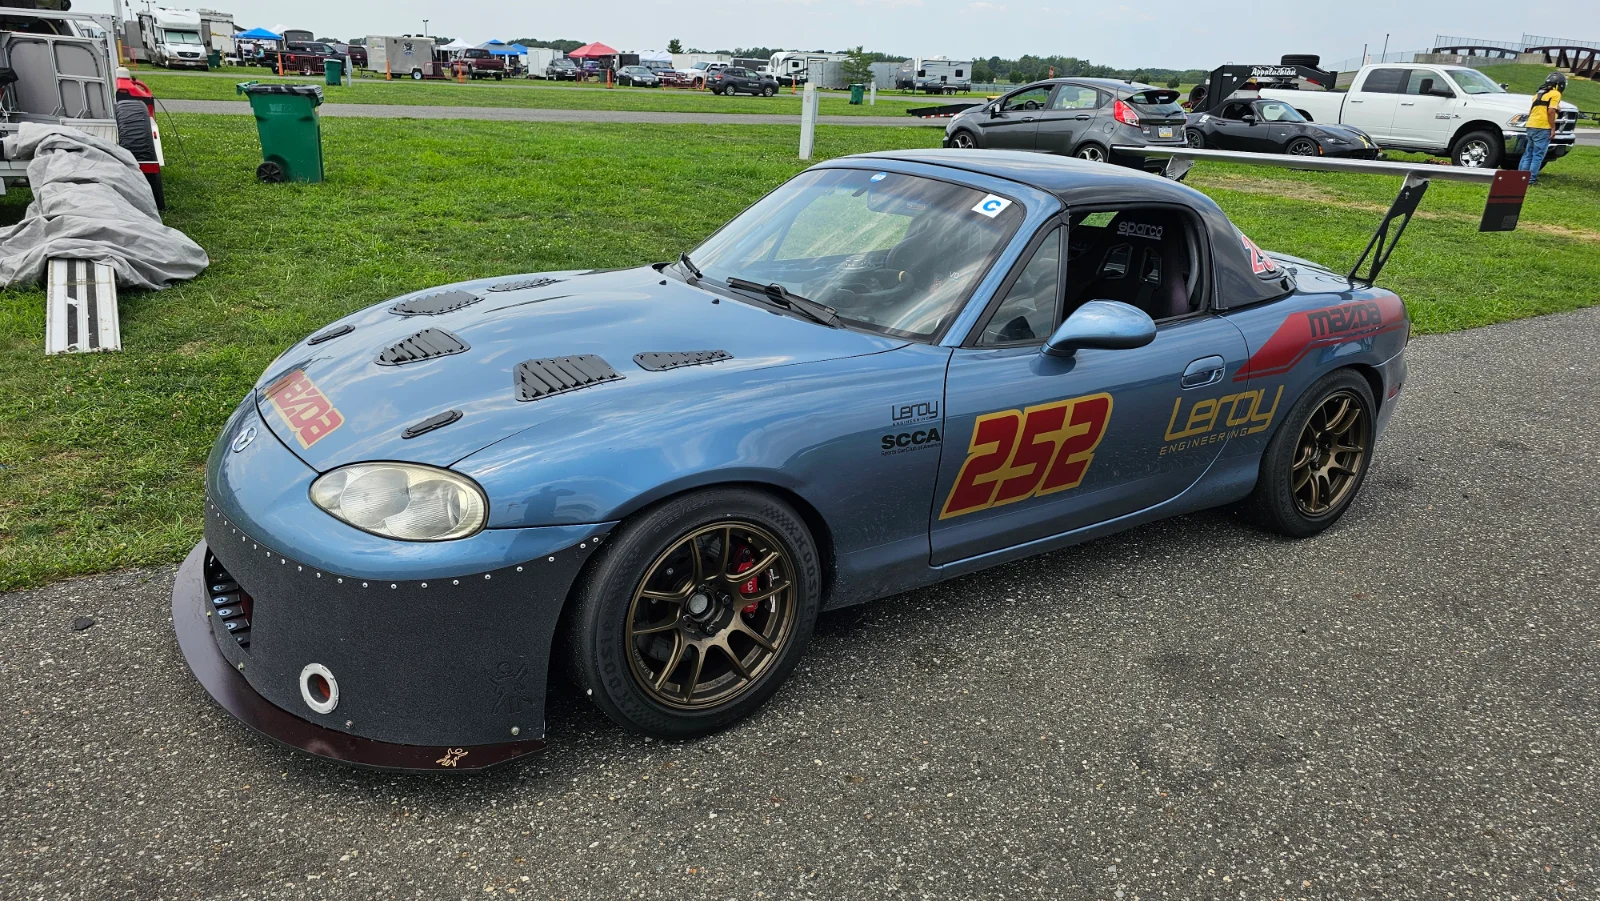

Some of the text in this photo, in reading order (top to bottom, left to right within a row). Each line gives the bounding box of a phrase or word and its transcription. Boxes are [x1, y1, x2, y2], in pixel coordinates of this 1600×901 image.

[983, 200, 1001, 212] C
[1118, 221, 1163, 238] sparco
[892, 400, 938, 421] Leroy
[1164, 385, 1284, 442] Leroy
[881, 427, 941, 450] SCCA
[1159, 427, 1249, 456] ENGINEERING
[938, 392, 1114, 521] 252
